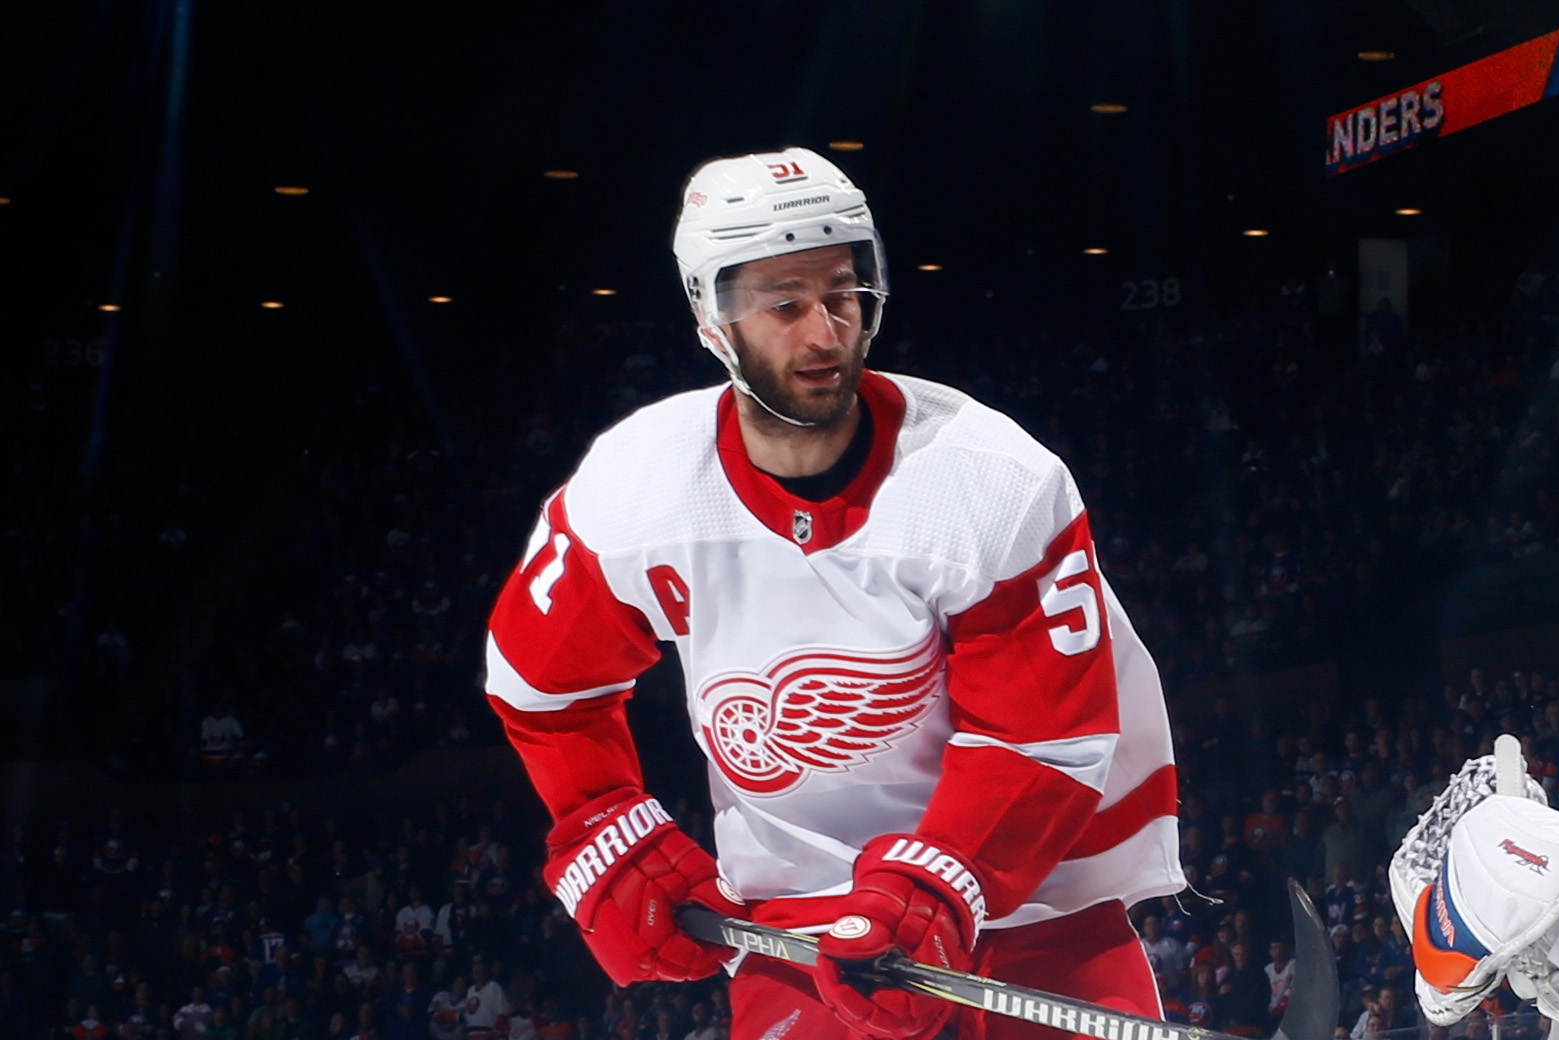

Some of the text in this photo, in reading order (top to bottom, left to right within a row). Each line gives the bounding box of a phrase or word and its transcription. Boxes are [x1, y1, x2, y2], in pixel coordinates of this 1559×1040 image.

[1326, 81, 1444, 165] NDERS
[773, 195, 831, 212] WARRIOR
[1120, 276, 1182, 312] 238
[646, 564, 690, 636] A
[1040, 549, 1112, 656] 5
[554, 798, 674, 919] WARRIOR
[882, 838, 988, 952] WARR
